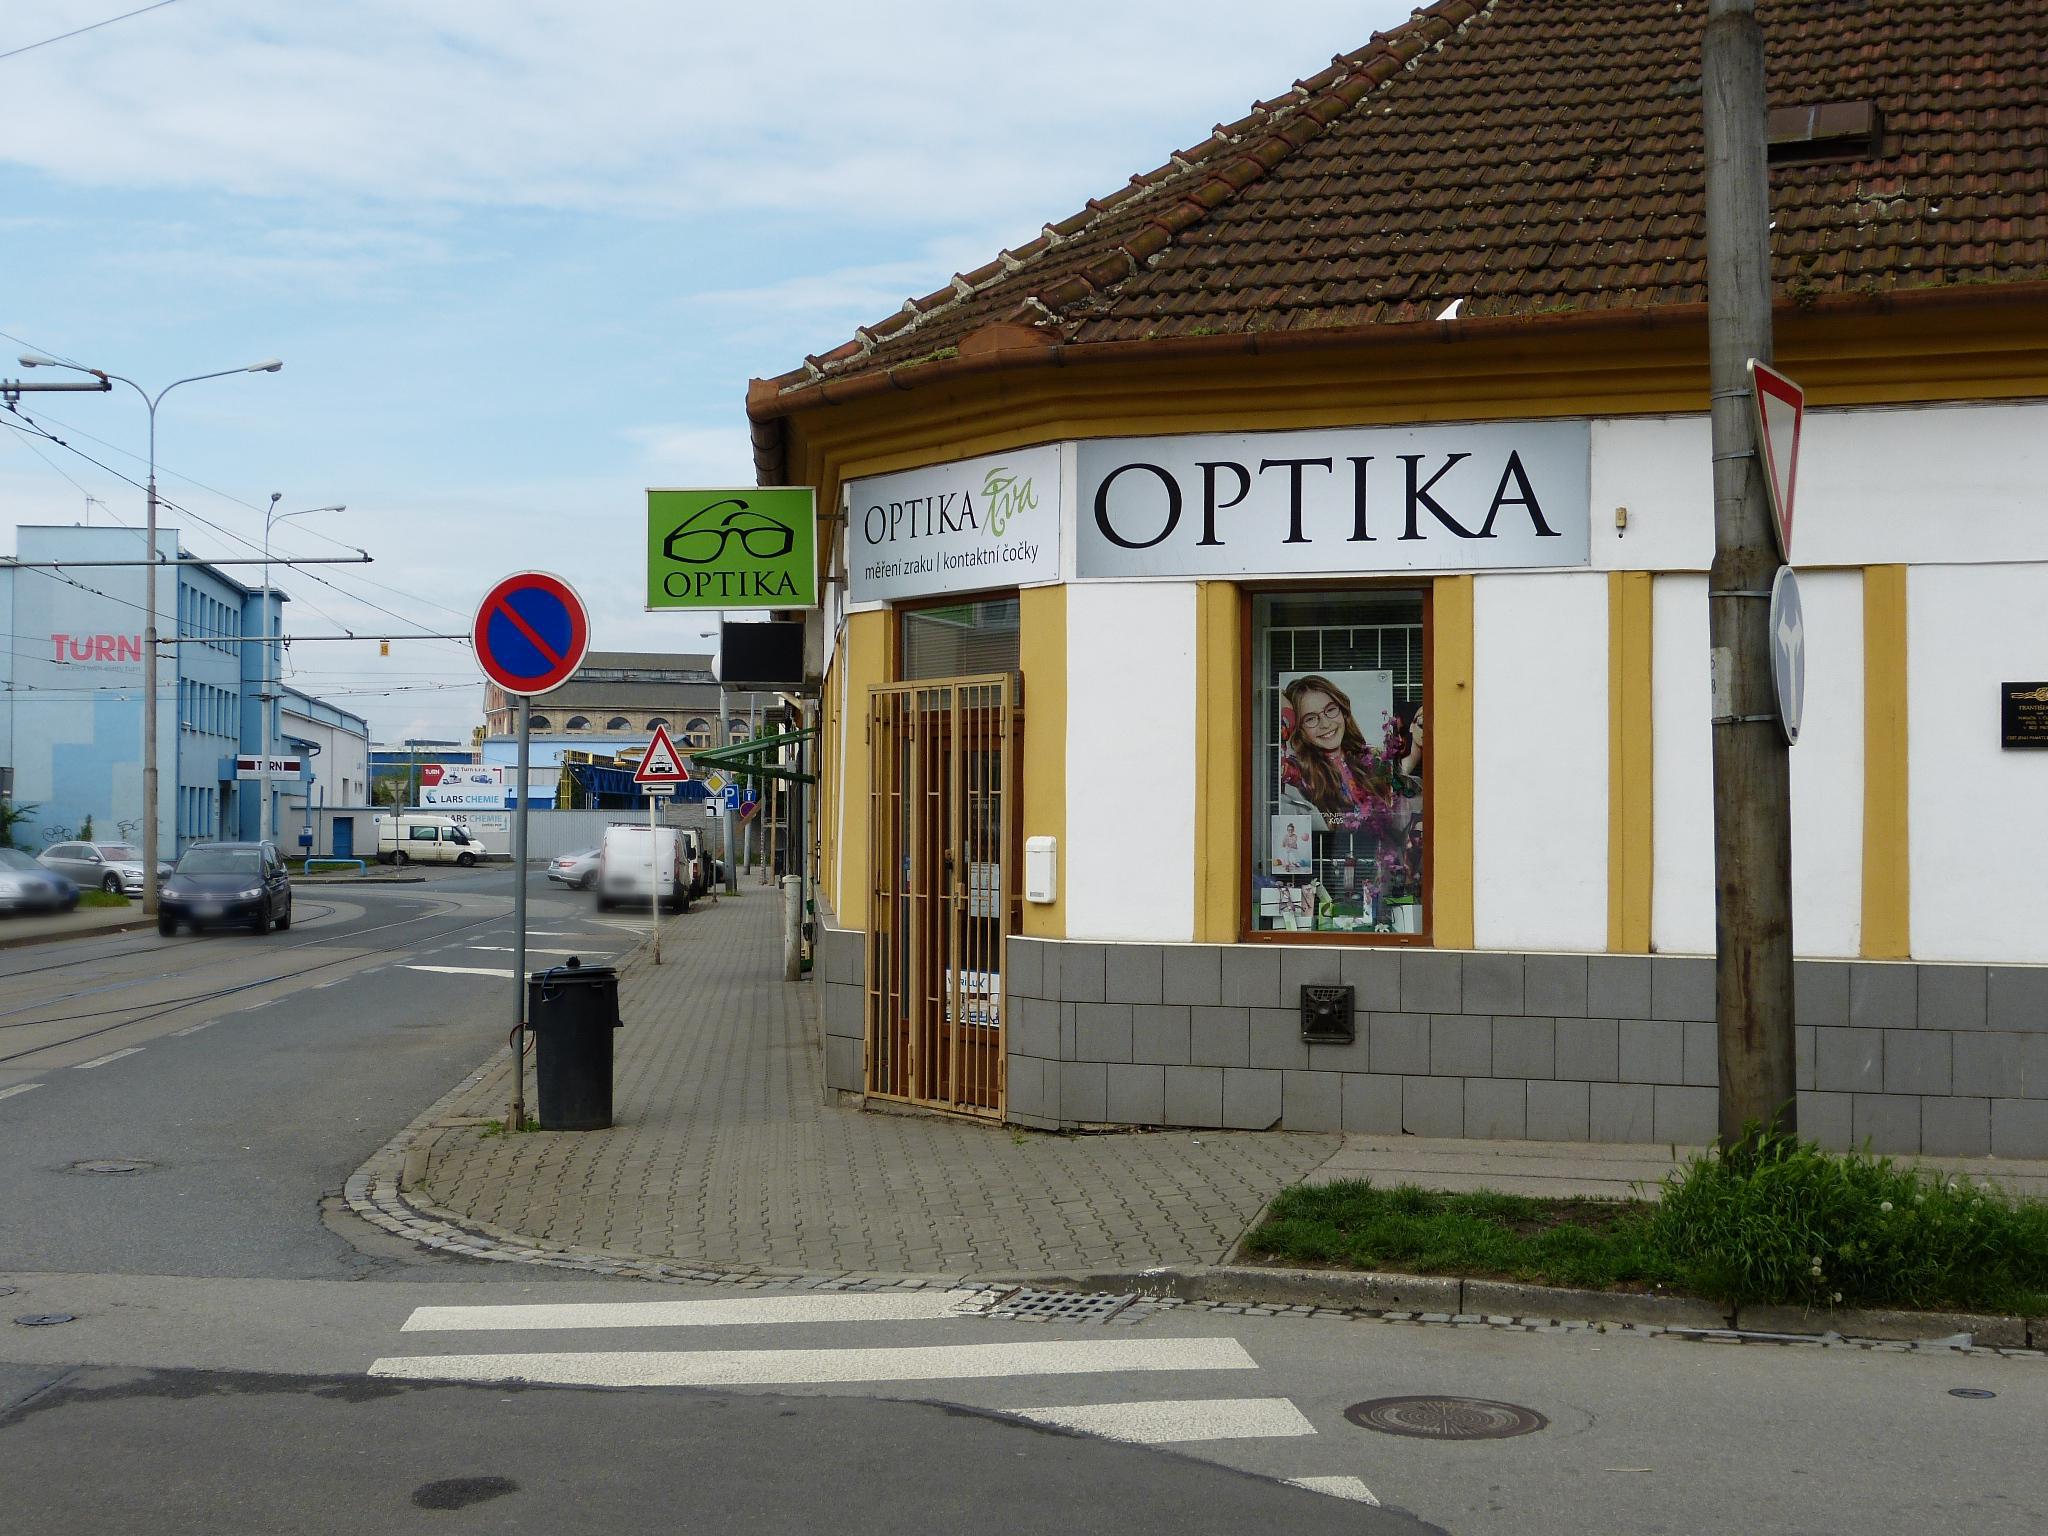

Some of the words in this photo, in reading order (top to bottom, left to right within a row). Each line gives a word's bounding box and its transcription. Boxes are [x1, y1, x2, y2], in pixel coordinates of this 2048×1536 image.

[1093, 449, 1562, 550] OPTIKA
[864, 490, 979, 545] OPTIKA
[865, 558, 901, 580] měření
[903, 555, 933, 575] zraku
[943, 544, 1000, 570] kontaktní
[1002, 540, 1039, 564] čočky
[663, 570, 800, 598] OPTIKA
[50, 634, 142, 662] TURN
[257, 760, 283, 771] TRN
[440, 795, 464, 804] LARS
[465, 795, 499, 804] CHEMIE
[724, 787, 735, 803] P
[444, 814, 468, 823] ARS
[469, 814, 503, 823] CHEMIE
